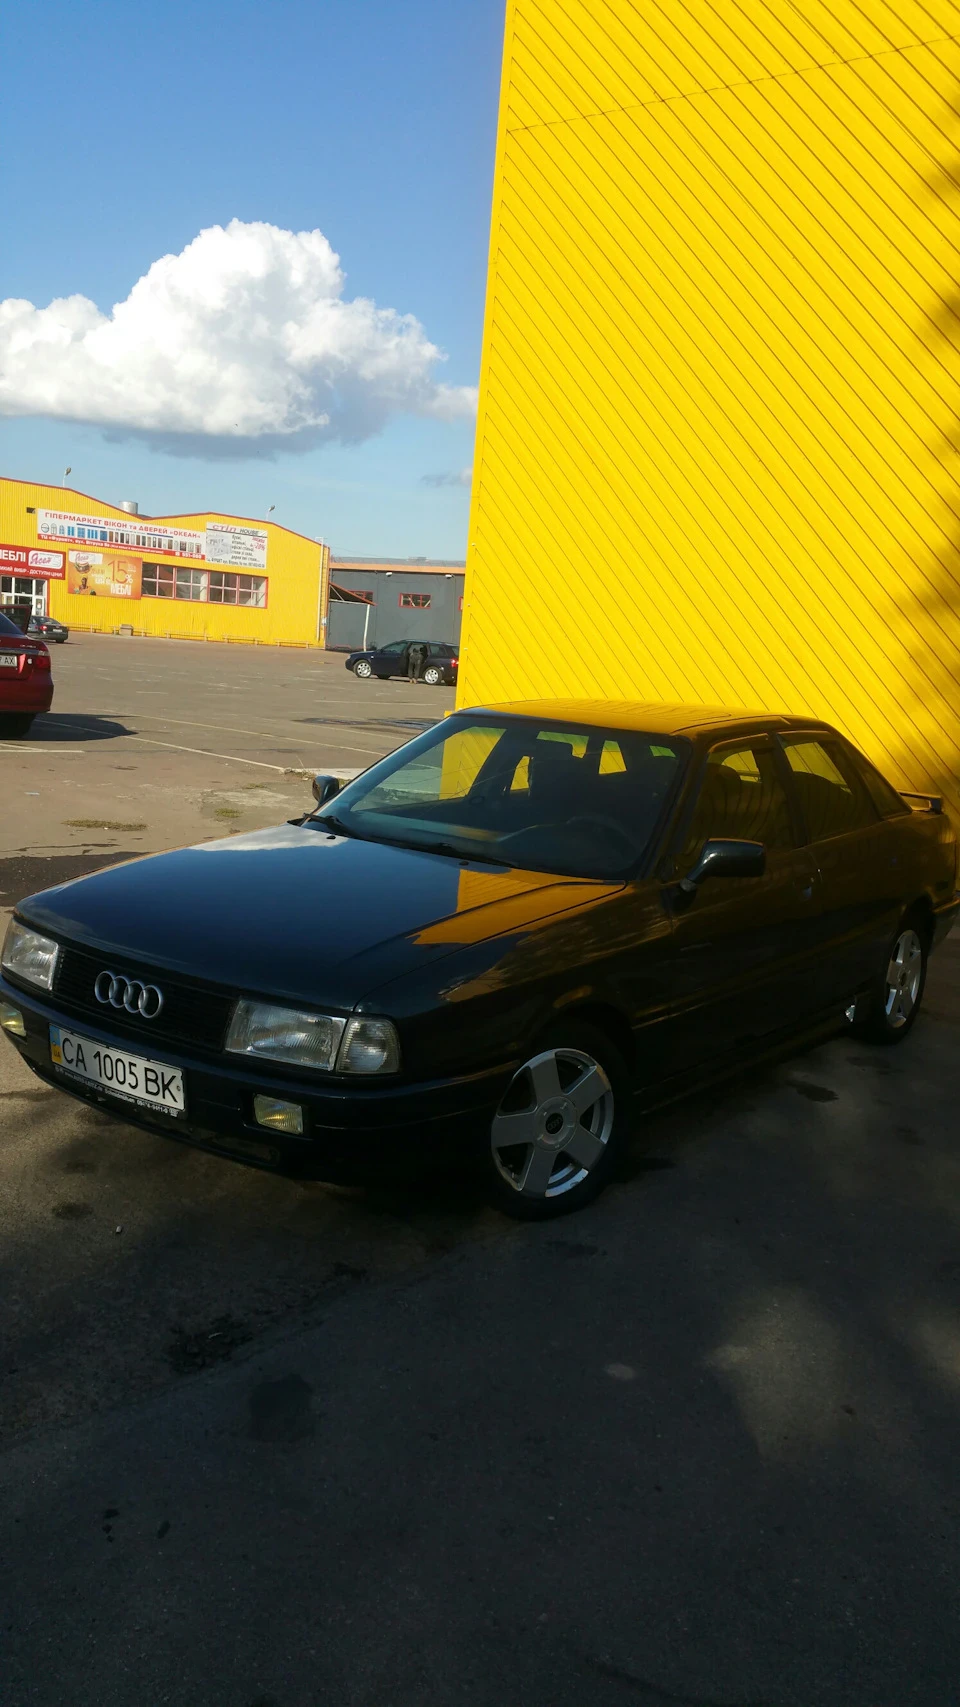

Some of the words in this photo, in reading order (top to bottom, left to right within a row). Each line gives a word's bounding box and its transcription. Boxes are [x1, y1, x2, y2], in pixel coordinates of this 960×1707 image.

[45, 512, 102, 525] ГІПЕРМАРКЕТ
[104, 520, 127, 528] ВІКОН
[139, 525, 168, 534] ДВЕРЕЙ
[0, 548, 26, 562] ЕБЛІ
[111, 583, 132, 595] МЕБЛІ
[62, 1037, 87, 1072] CA
[93, 1051, 138, 1089] 1005
[144, 1066, 178, 1103] BK
